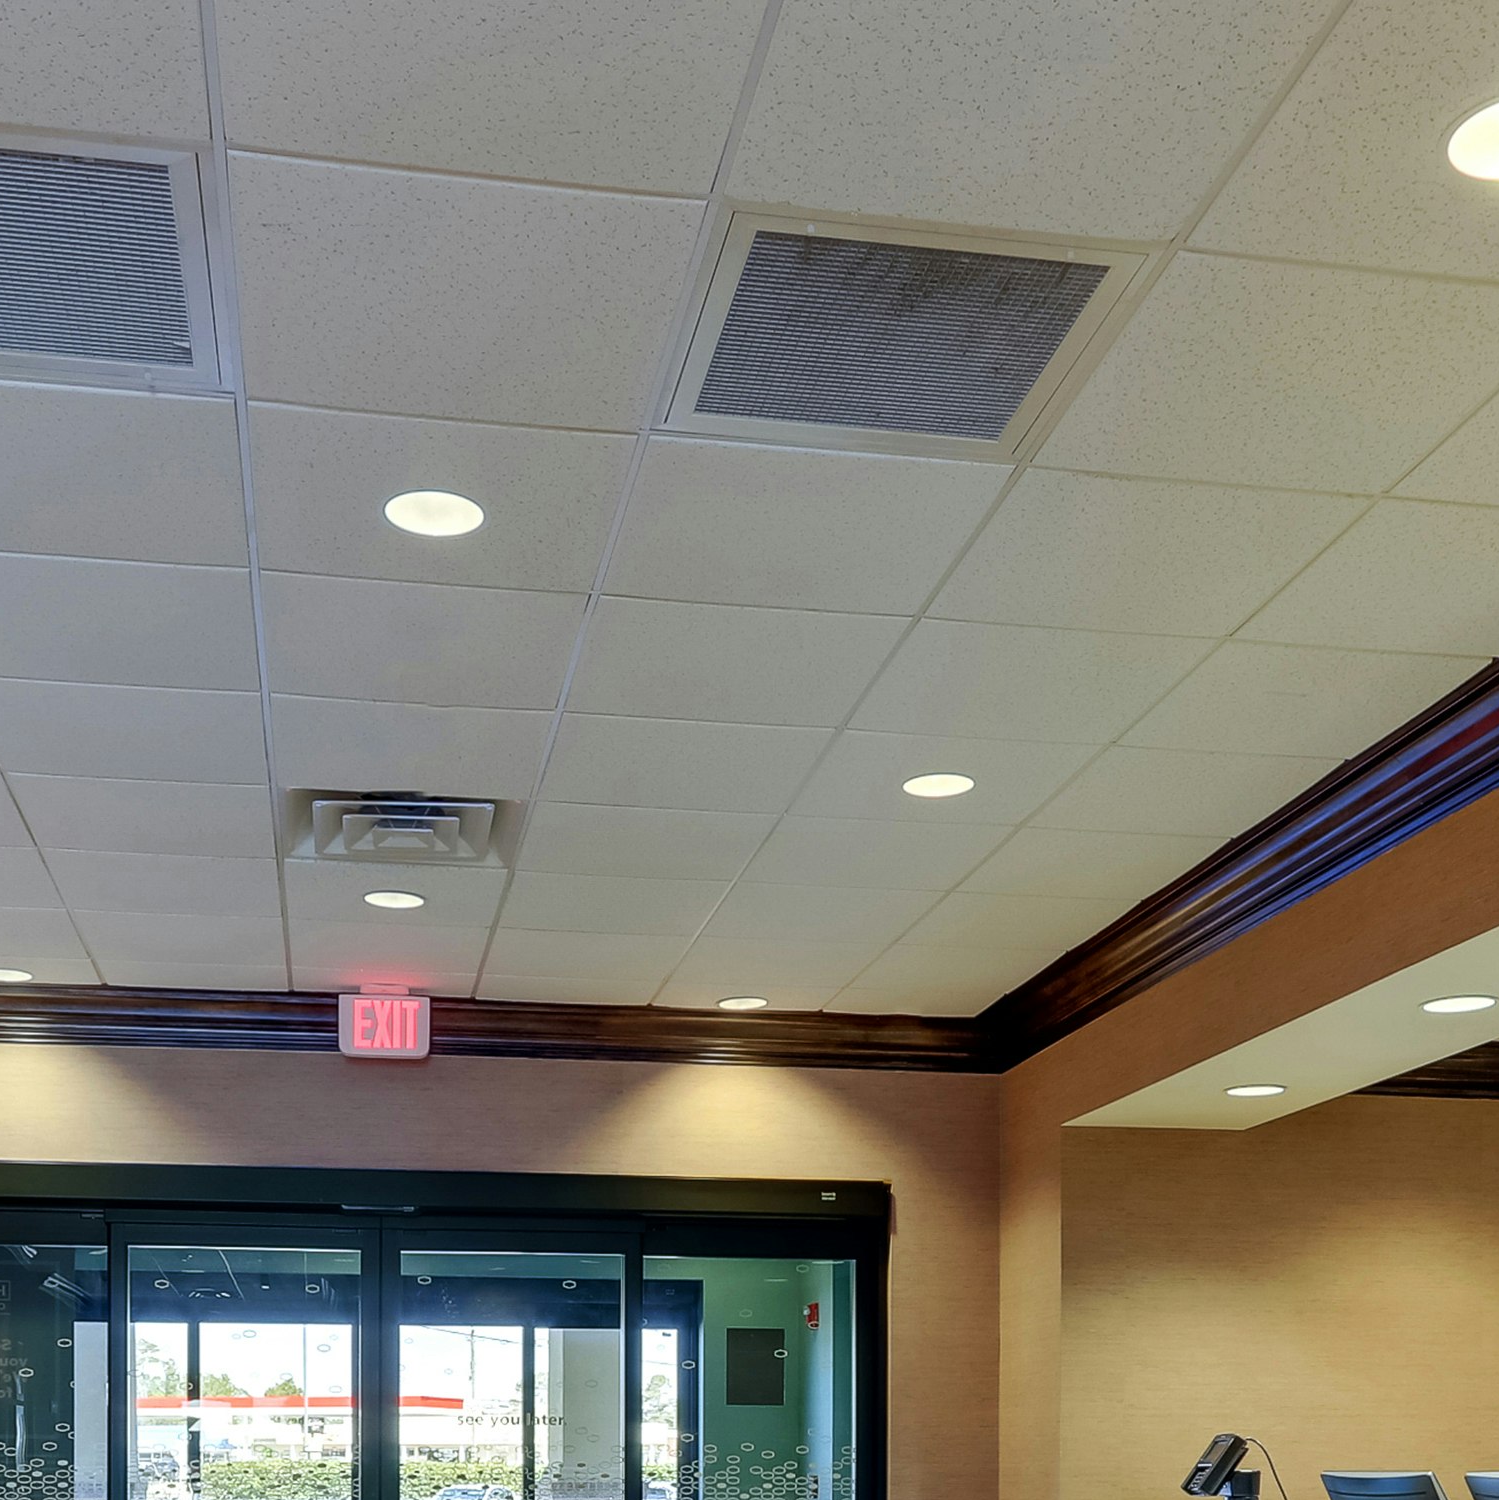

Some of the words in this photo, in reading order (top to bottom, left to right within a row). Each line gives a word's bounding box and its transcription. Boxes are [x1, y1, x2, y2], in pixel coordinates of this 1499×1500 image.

[353, 999, 421, 1049] EXIT
[457, 1415, 484, 1426] see
[490, 1415, 521, 1428] you
